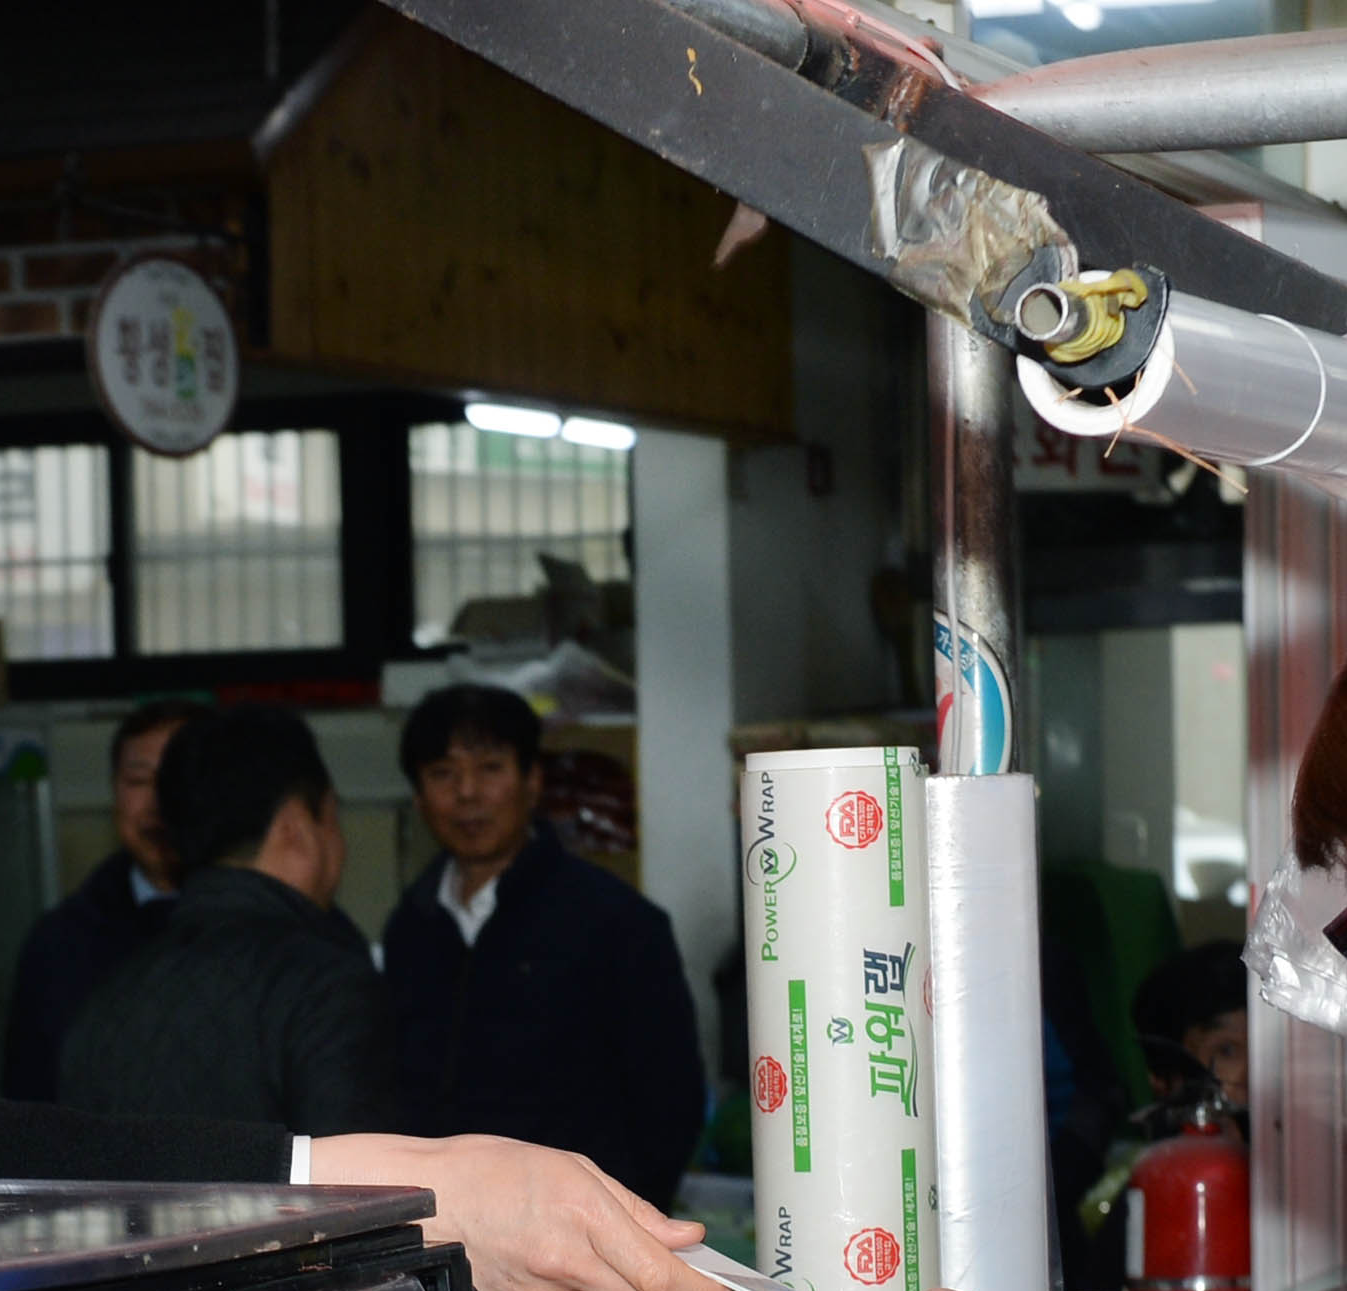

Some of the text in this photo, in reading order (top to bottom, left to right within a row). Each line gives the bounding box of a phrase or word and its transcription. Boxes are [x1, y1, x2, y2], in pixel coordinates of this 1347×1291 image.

[758, 771, 775, 841] WRAP
[839, 800, 855, 837] FDA
[761, 882, 780, 962] POWER
[863, 945, 912, 1117] 파워랩
[774, 1206, 792, 1277] WRAP
[857, 1237, 873, 1273] FDA
